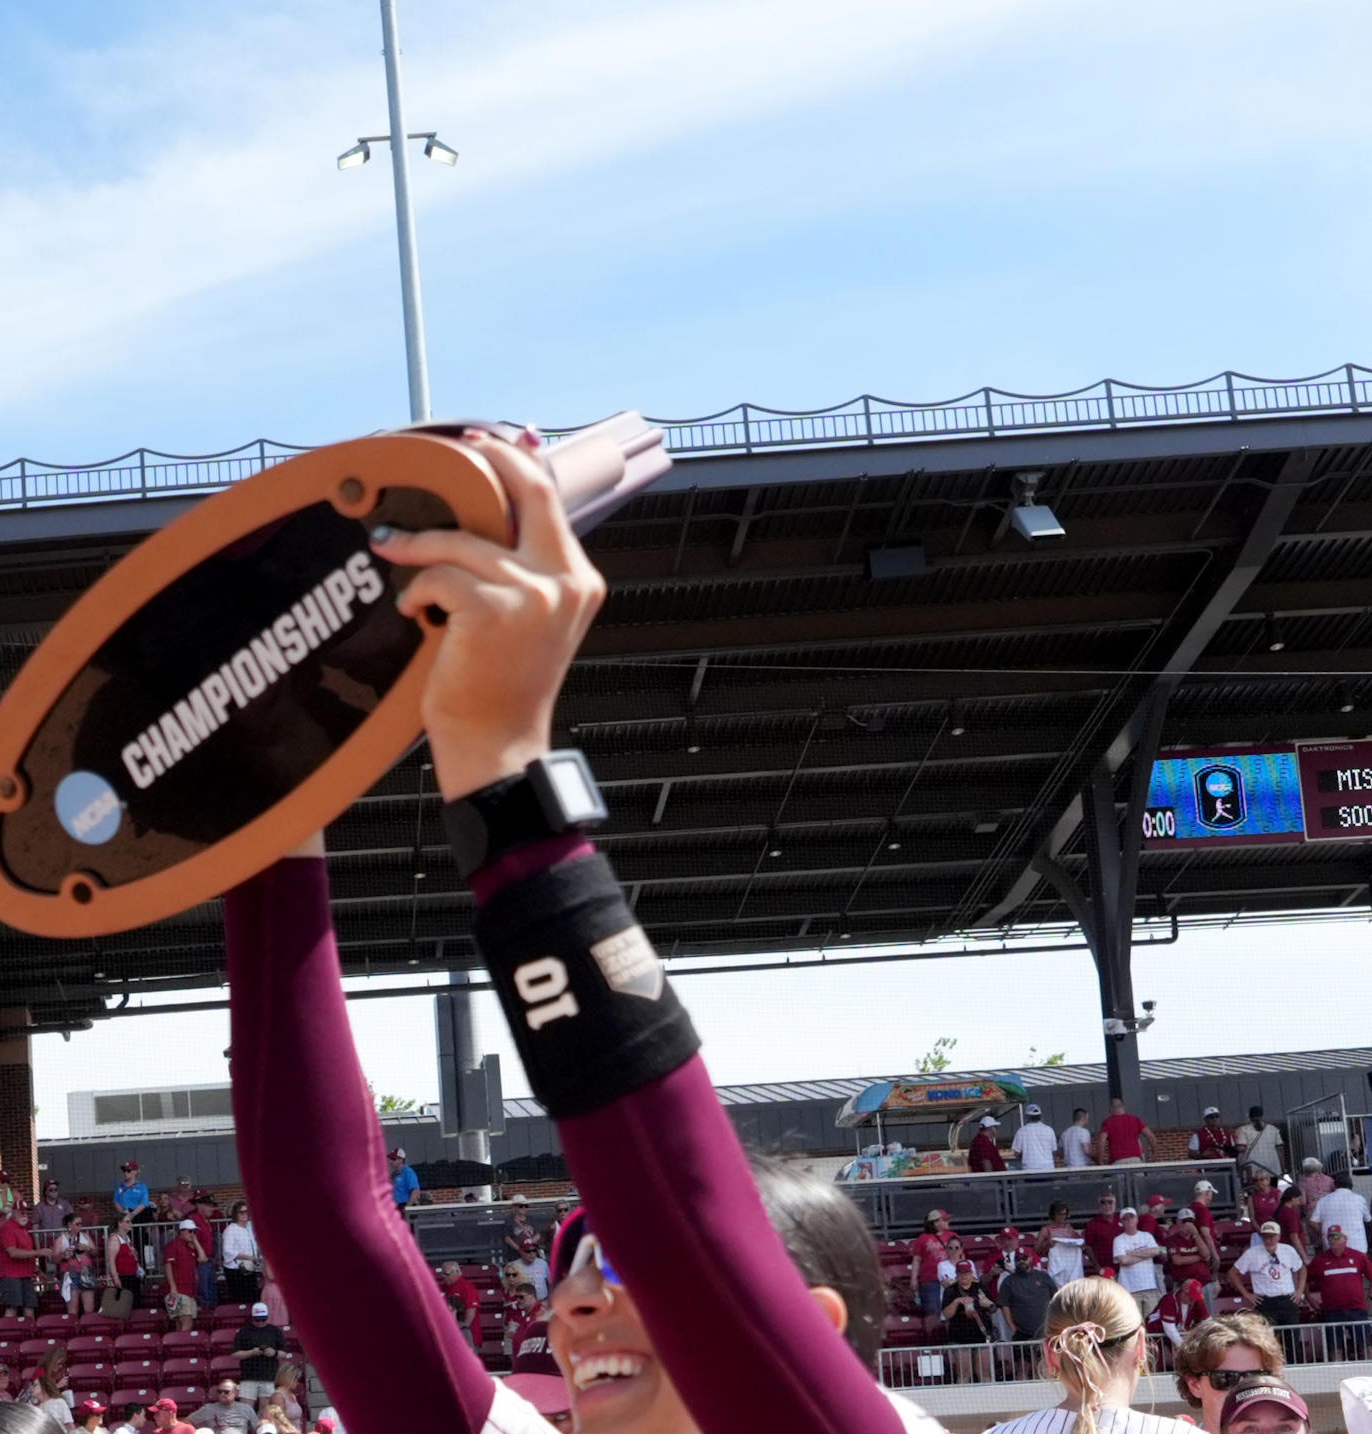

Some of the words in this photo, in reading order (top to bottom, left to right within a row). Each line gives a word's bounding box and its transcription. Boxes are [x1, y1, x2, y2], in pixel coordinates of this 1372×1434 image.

[120, 550, 385, 790] CHAMPIONSHIPS
[1235, 1386, 1271, 1403] MISSISSIPPI
[1272, 1386, 1291, 1400] STATE
